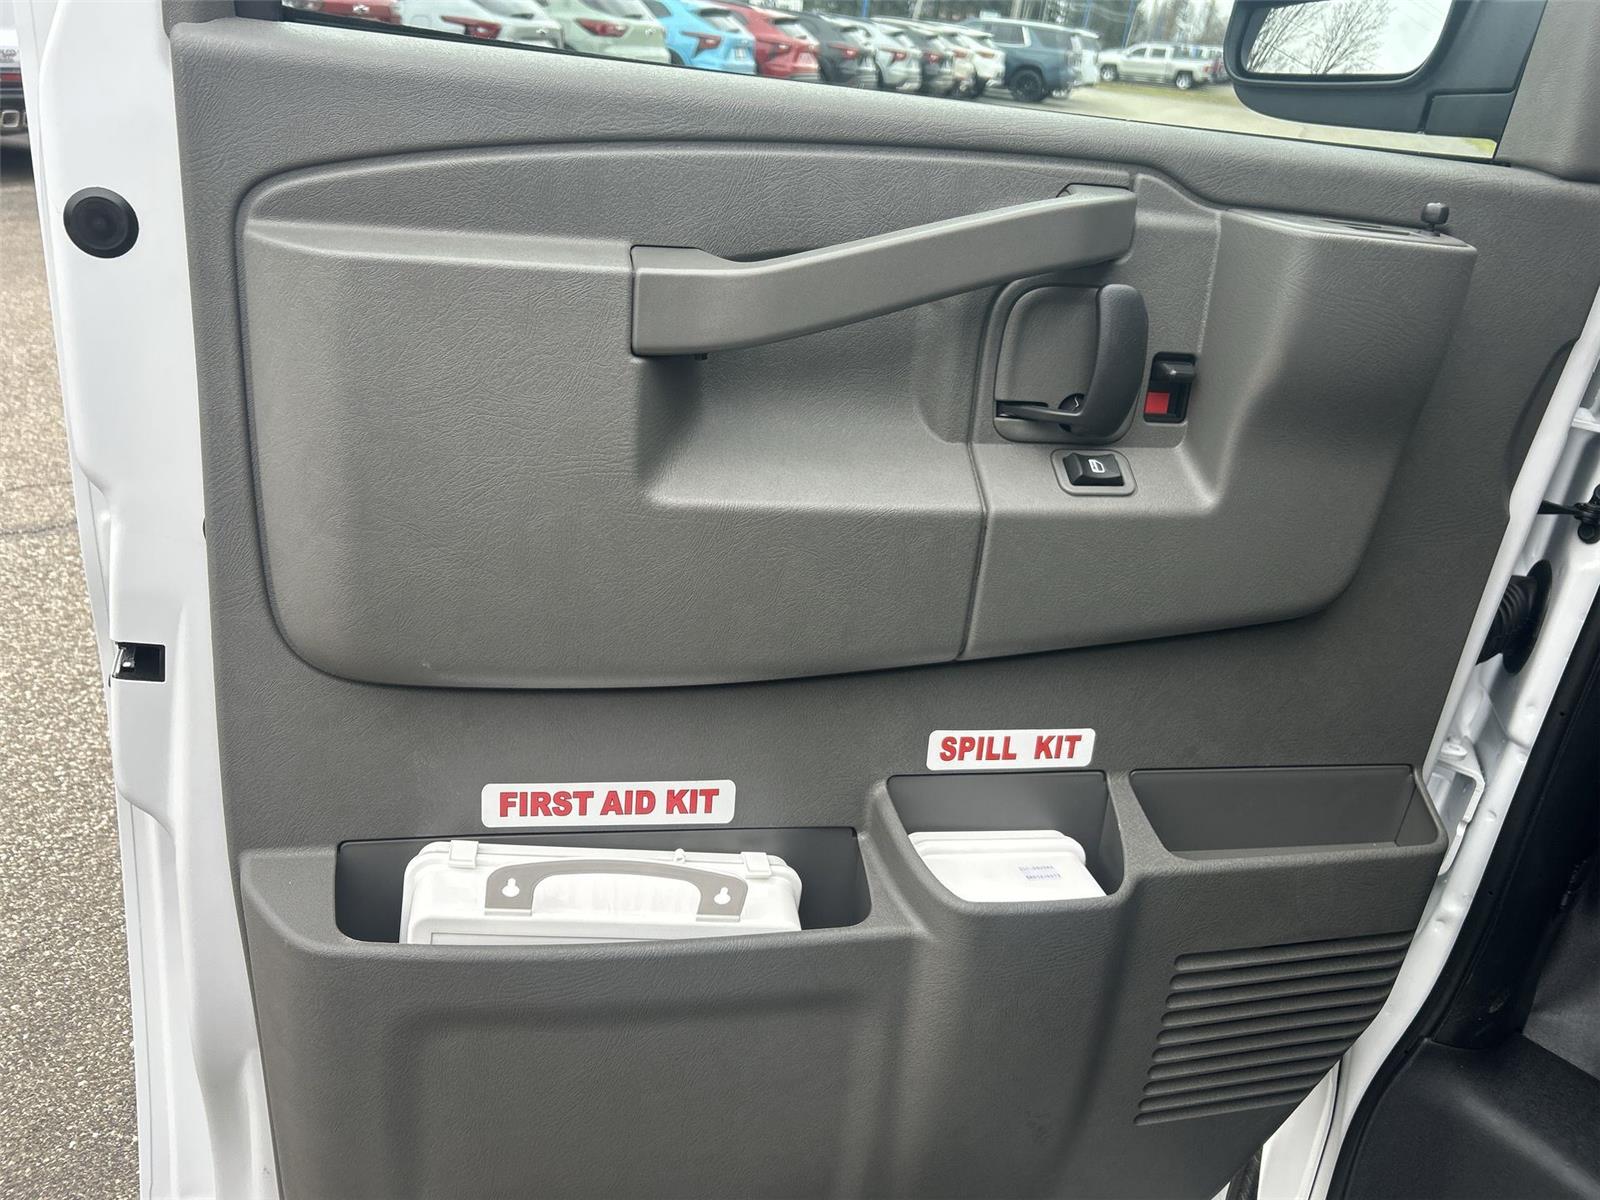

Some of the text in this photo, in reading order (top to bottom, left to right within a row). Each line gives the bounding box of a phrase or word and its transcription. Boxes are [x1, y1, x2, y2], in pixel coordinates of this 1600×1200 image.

[939, 735, 1082, 762] SPILL KIT
[498, 788, 720, 818] FIRST AID KIT
